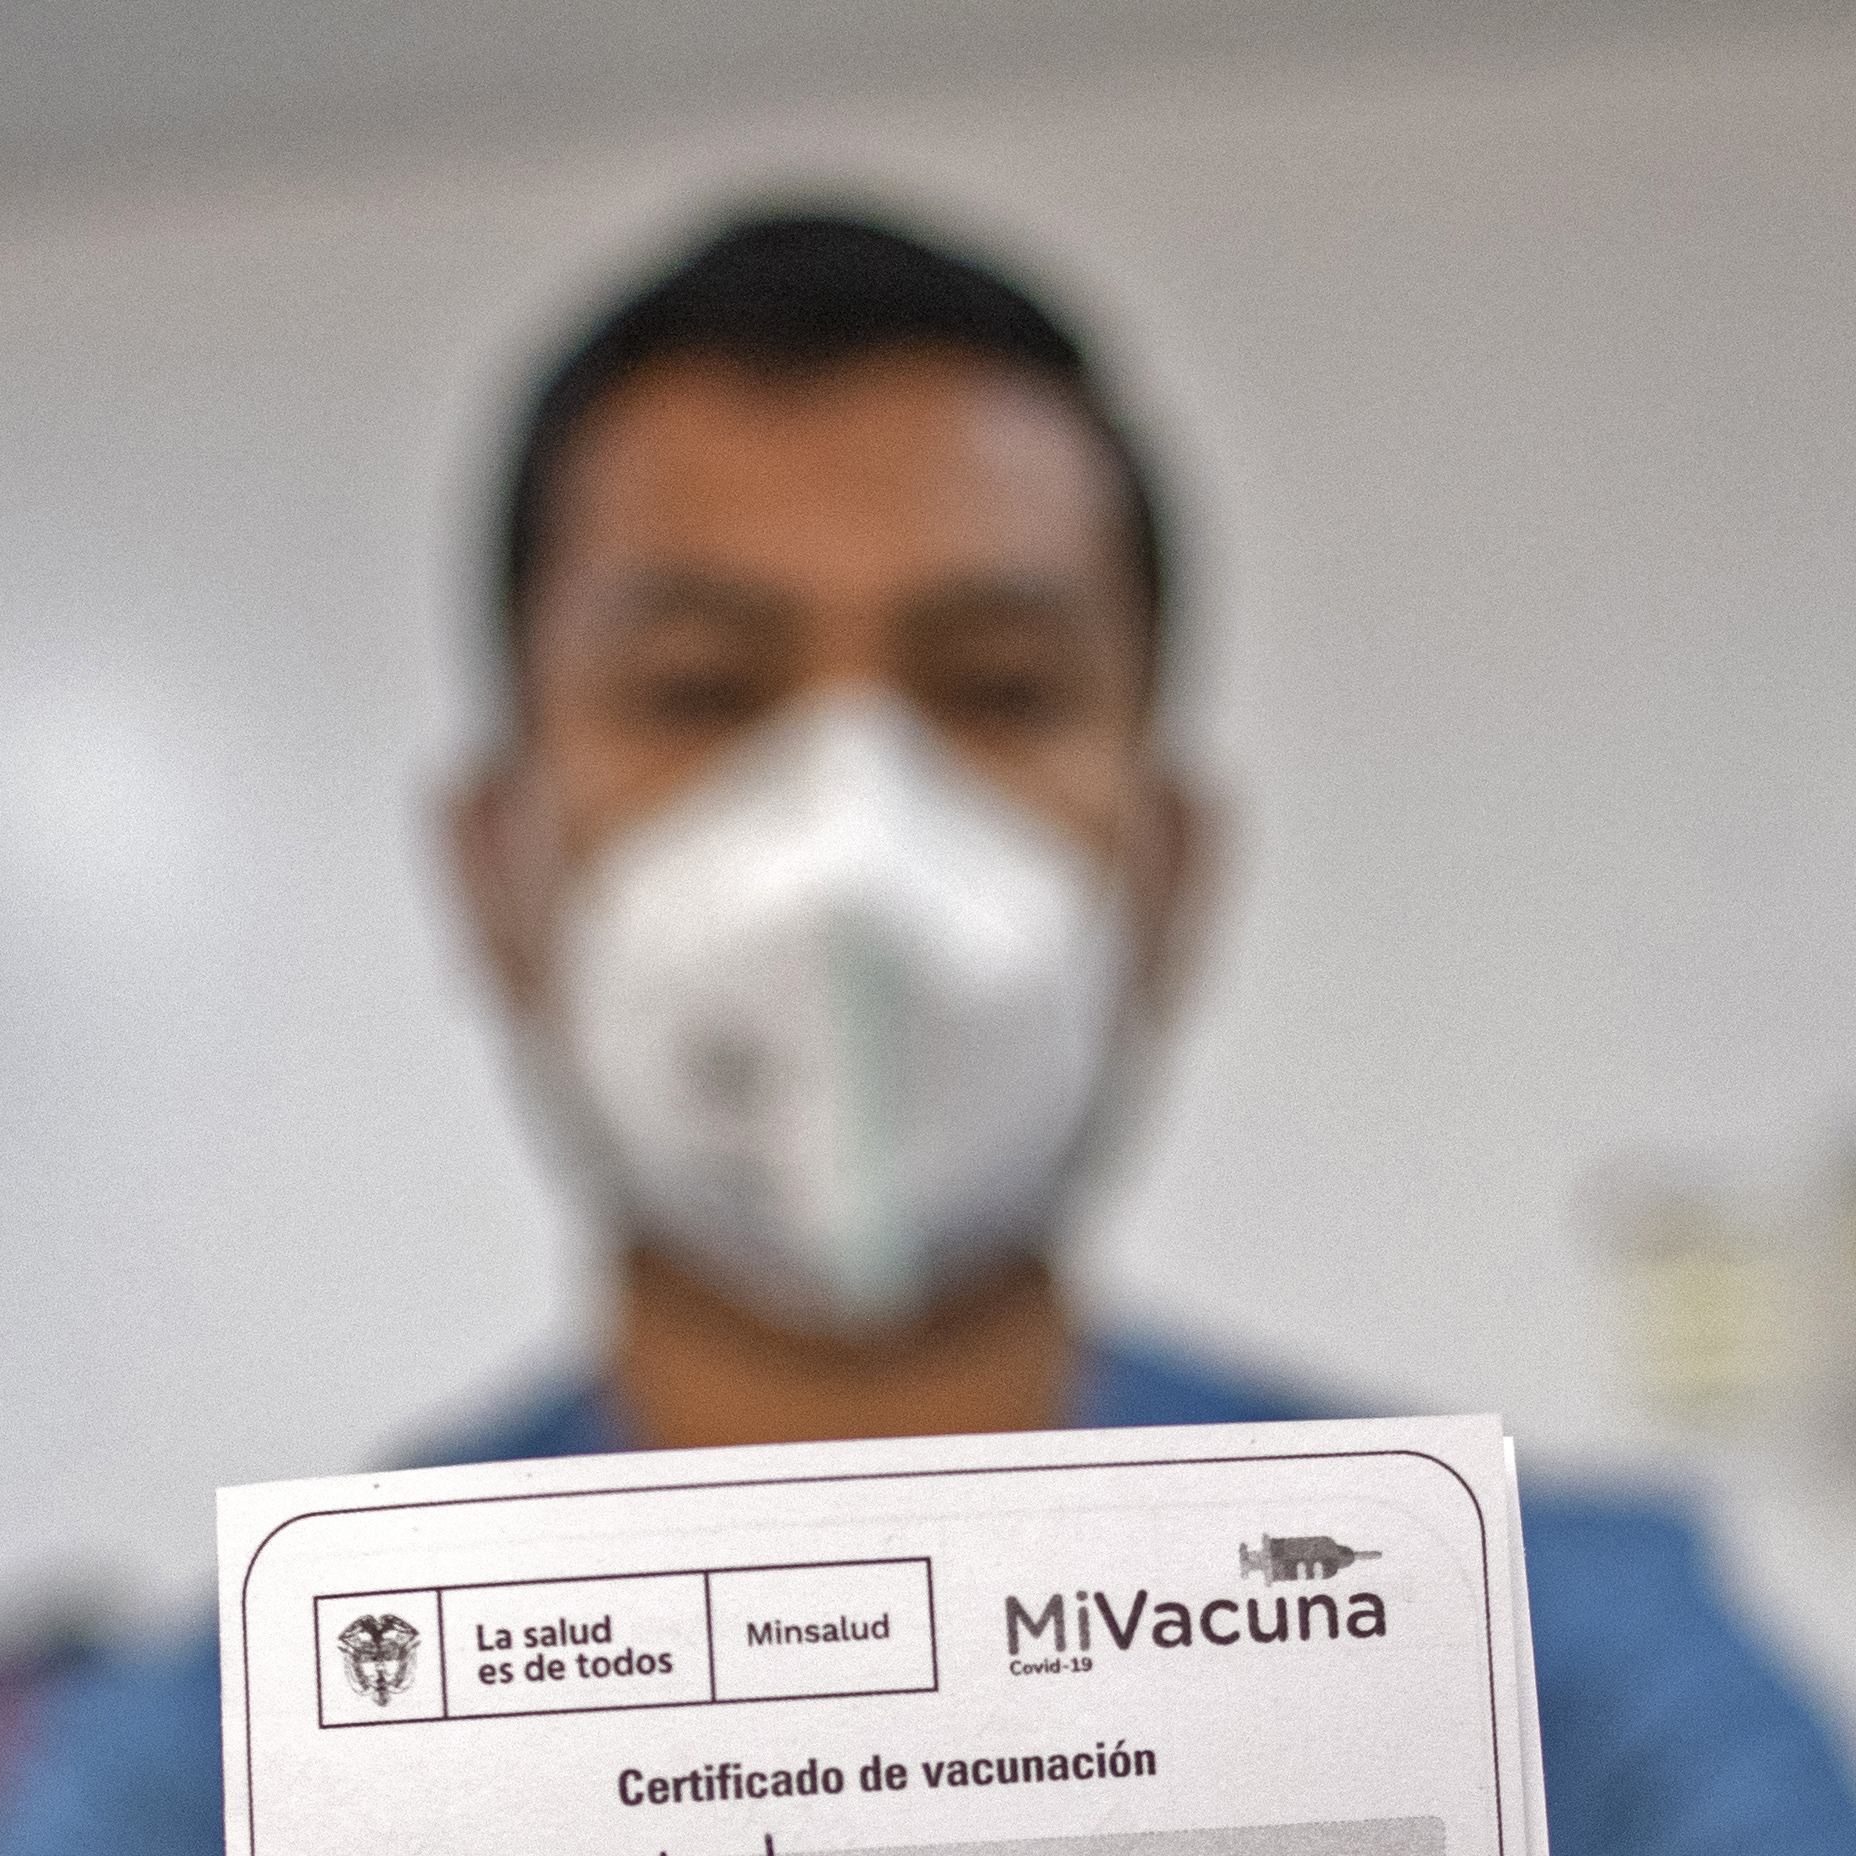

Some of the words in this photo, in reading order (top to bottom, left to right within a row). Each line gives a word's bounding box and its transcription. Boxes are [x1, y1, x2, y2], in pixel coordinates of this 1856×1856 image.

[476, 1624, 513, 1652] La
[524, 1614, 612, 1649] salud
[747, 1613, 890, 1646] Minsalud
[1005, 1589, 1387, 1656] MiVacuna
[478, 1662, 514, 1686] es
[524, 1653, 566, 1682] de
[576, 1647, 673, 1679] todos
[1009, 1656, 1094, 1676] Covid-19
[618, 1758, 845, 1807] Certificado
[859, 1754, 908, 1792] de
[922, 1739, 1157, 1788] vacunación
